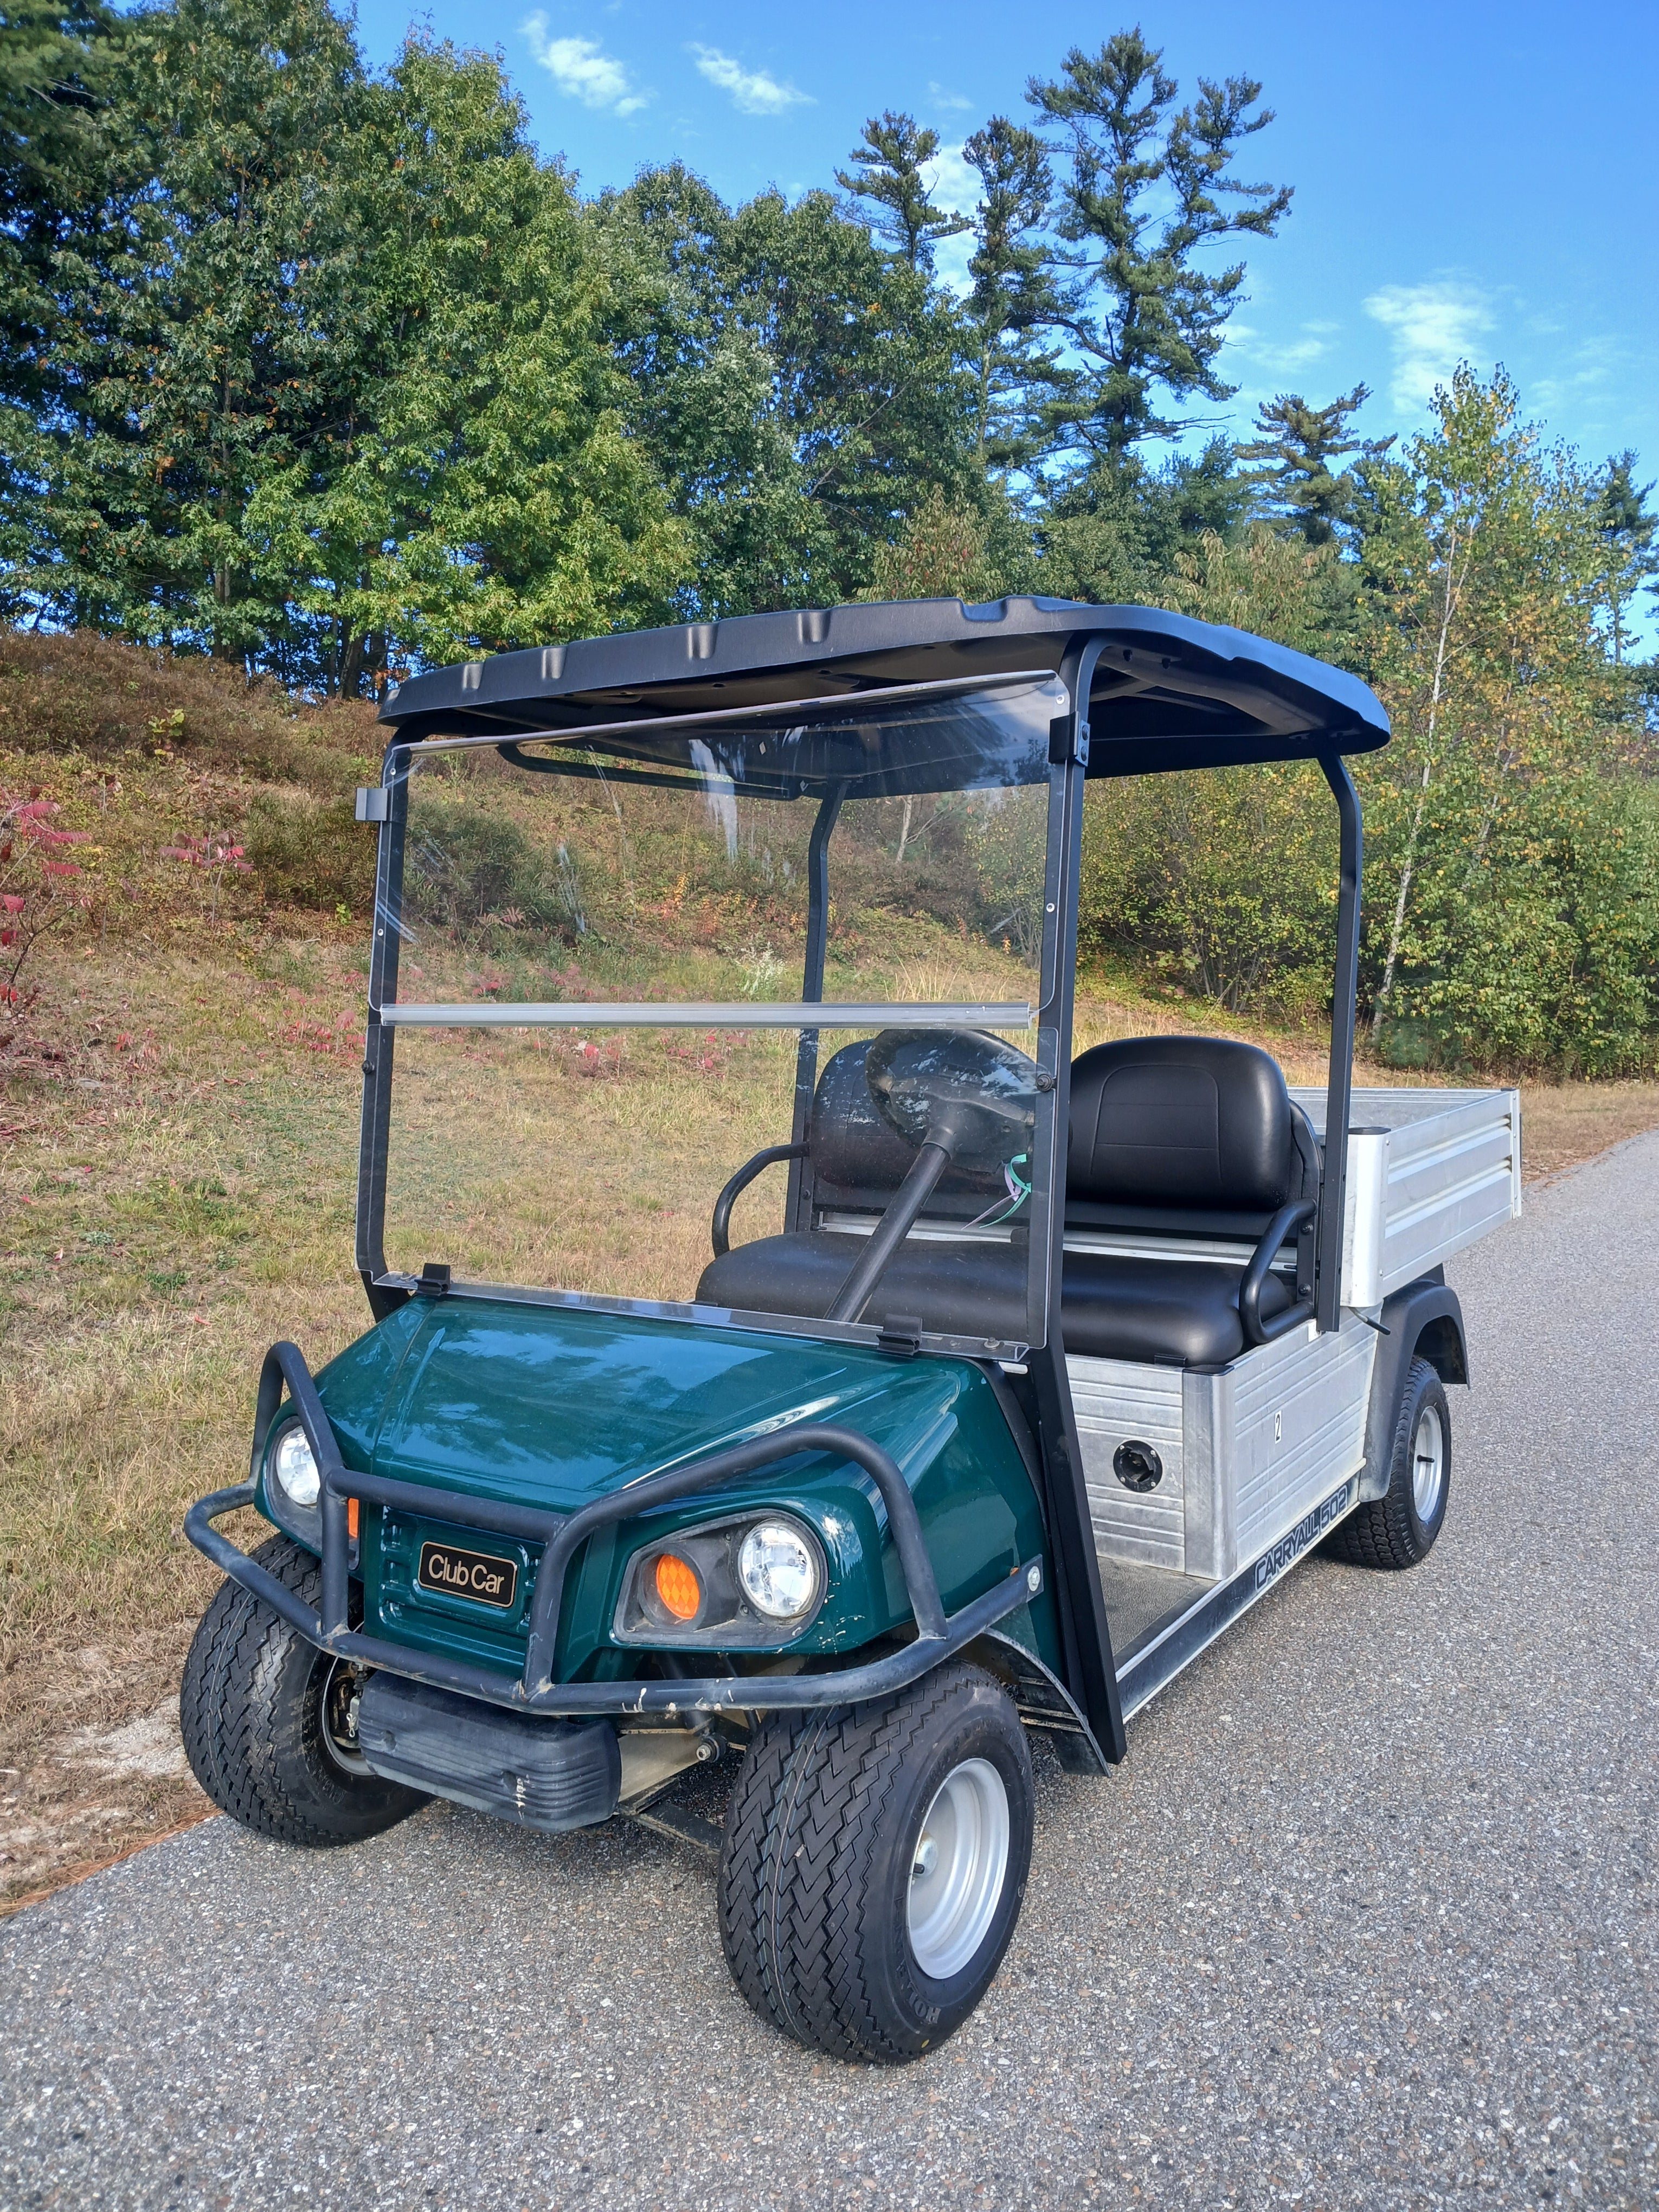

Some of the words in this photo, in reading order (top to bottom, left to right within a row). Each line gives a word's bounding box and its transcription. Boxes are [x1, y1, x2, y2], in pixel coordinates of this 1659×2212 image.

[1276, 1413, 1280, 1441] 2
[1255, 1512, 1320, 1592] CARRYALL
[1320, 1485, 1348, 1532] 502
[428, 1554, 469, 1586] Club
[471, 1564, 504, 1594] Car
